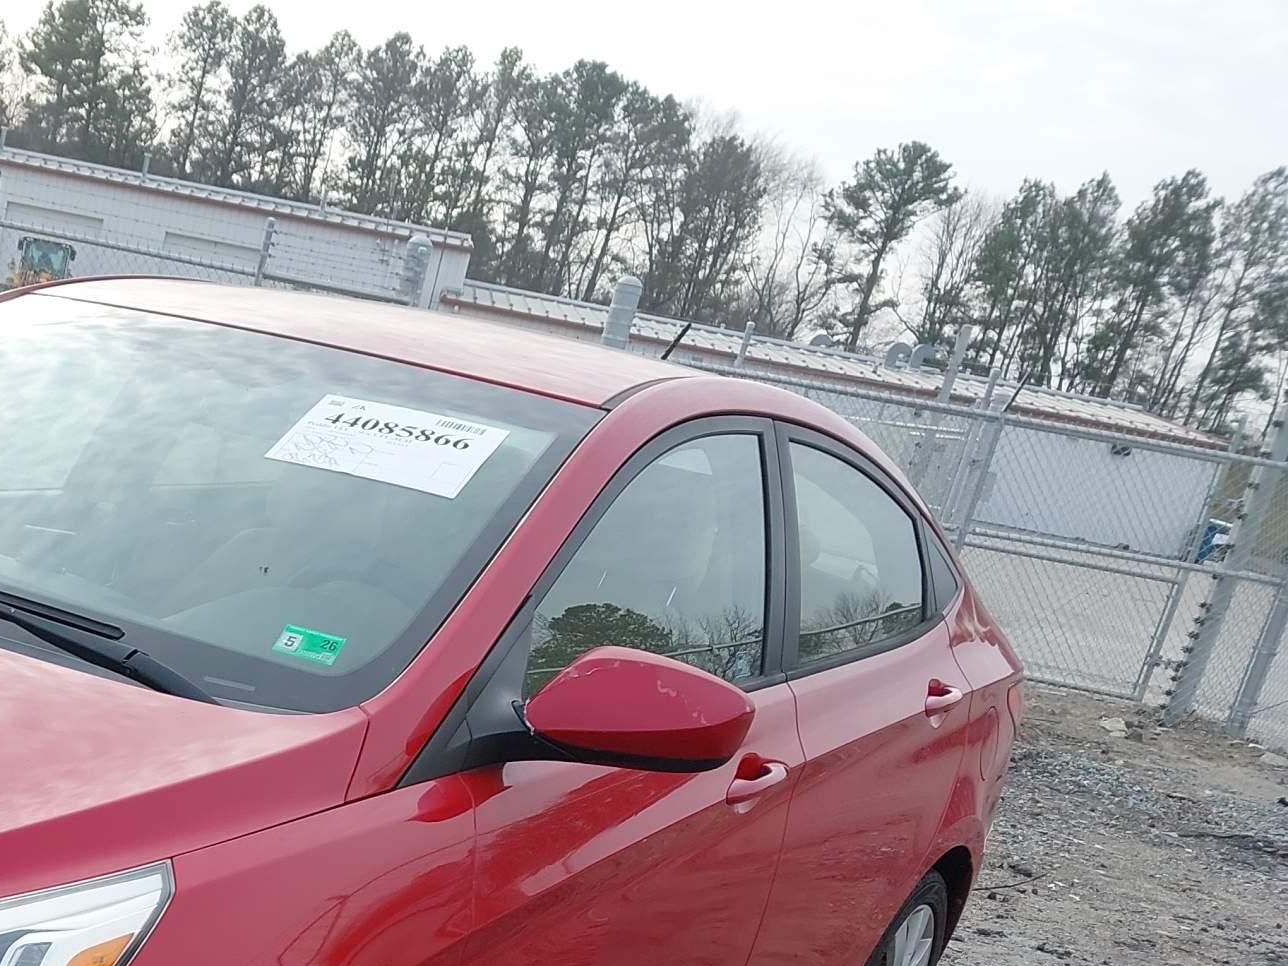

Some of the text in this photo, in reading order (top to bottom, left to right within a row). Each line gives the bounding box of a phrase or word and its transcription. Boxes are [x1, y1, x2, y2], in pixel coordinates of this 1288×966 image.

[324, 412, 475, 450] 44085866
[284, 635, 339, 652] 5 26
